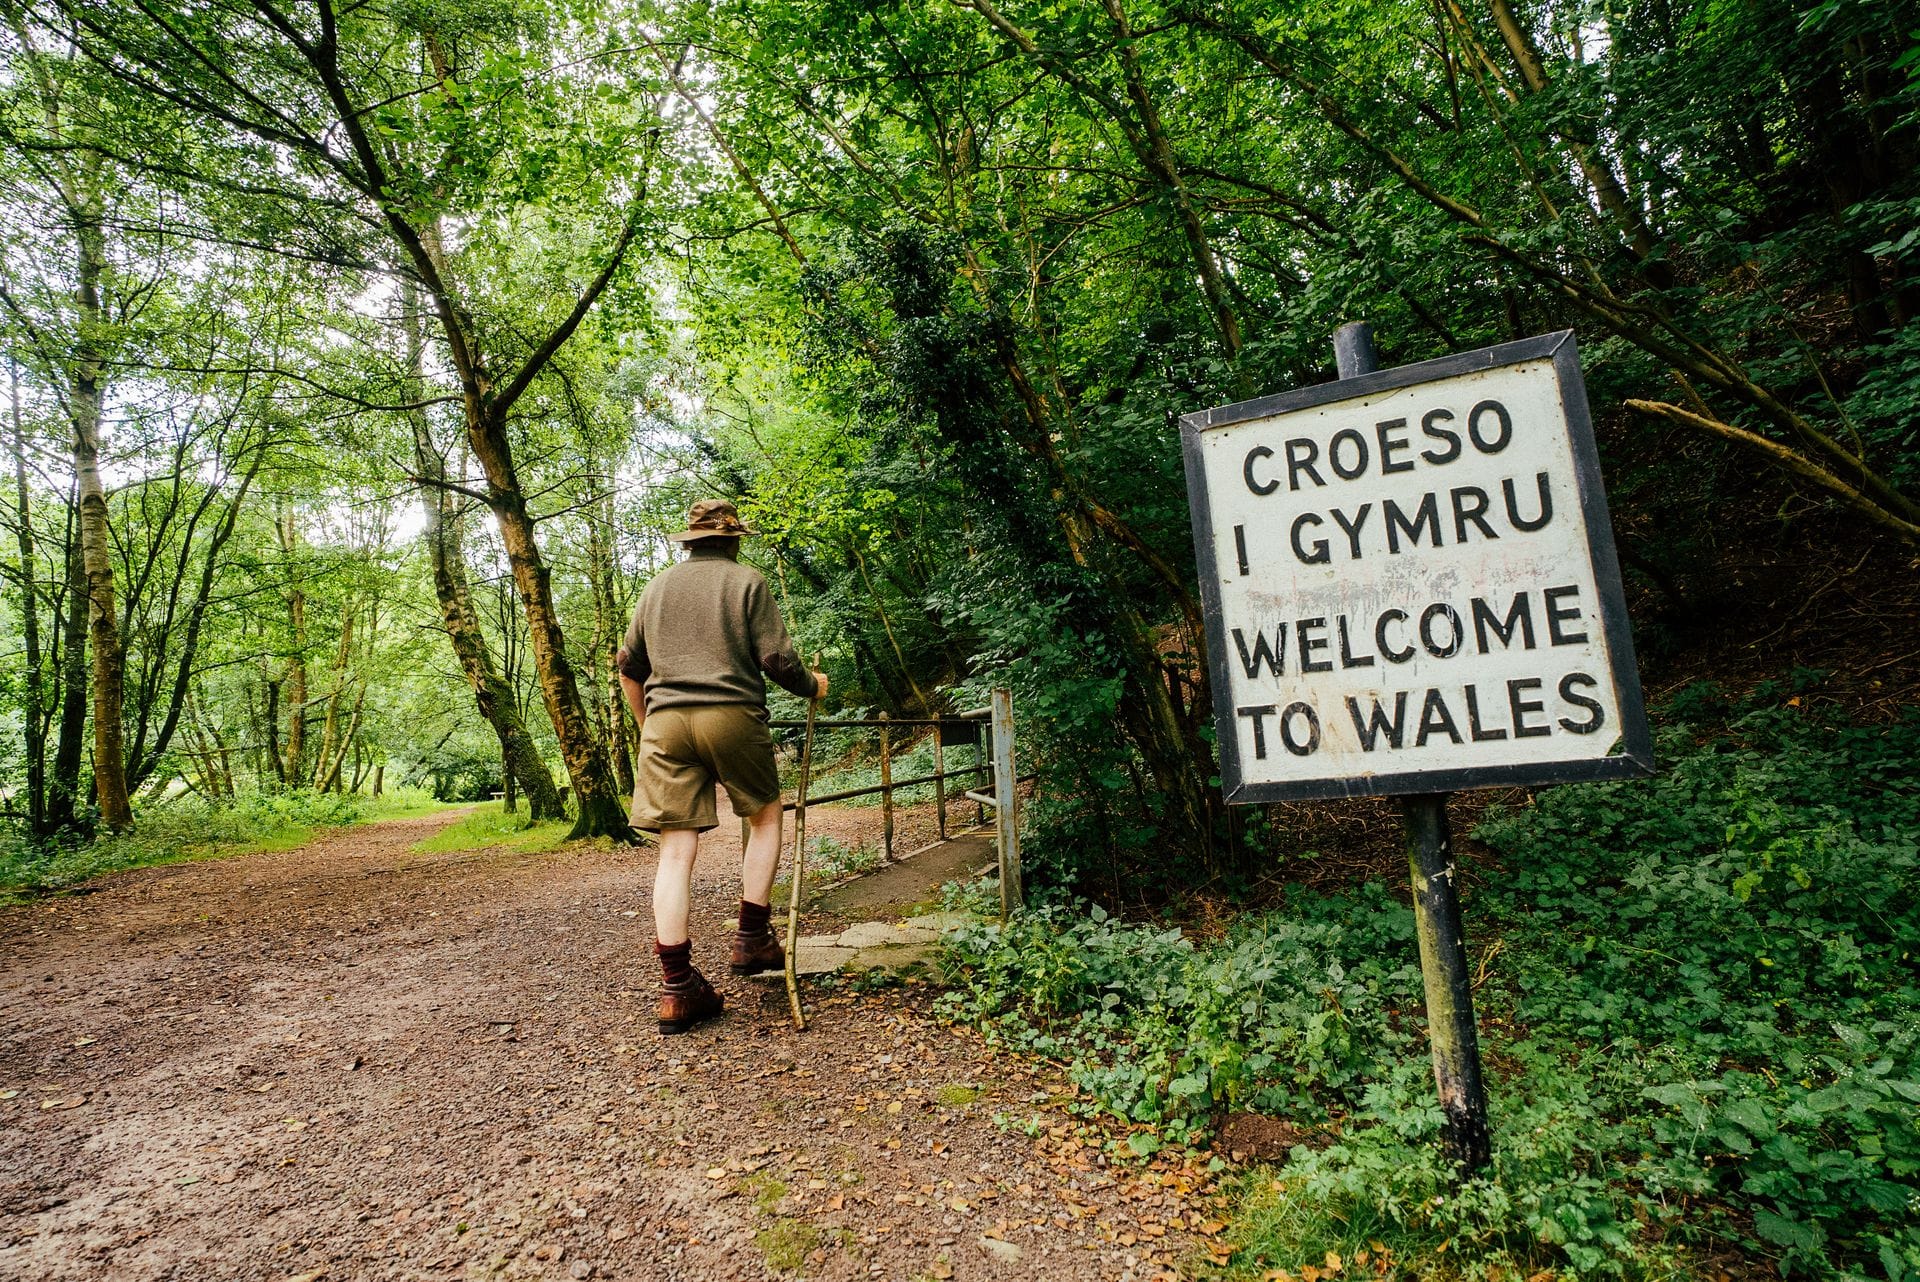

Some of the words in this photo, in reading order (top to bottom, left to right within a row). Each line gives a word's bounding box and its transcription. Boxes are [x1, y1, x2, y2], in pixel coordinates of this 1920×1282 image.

[1243, 399, 1513, 496] CROESO
[1233, 524, 1249, 576] I
[1290, 471, 1554, 565] GYMRU
[1231, 585, 1589, 680] WELCOME
[1237, 701, 1320, 760] TO
[1345, 672, 1605, 752] WALES
